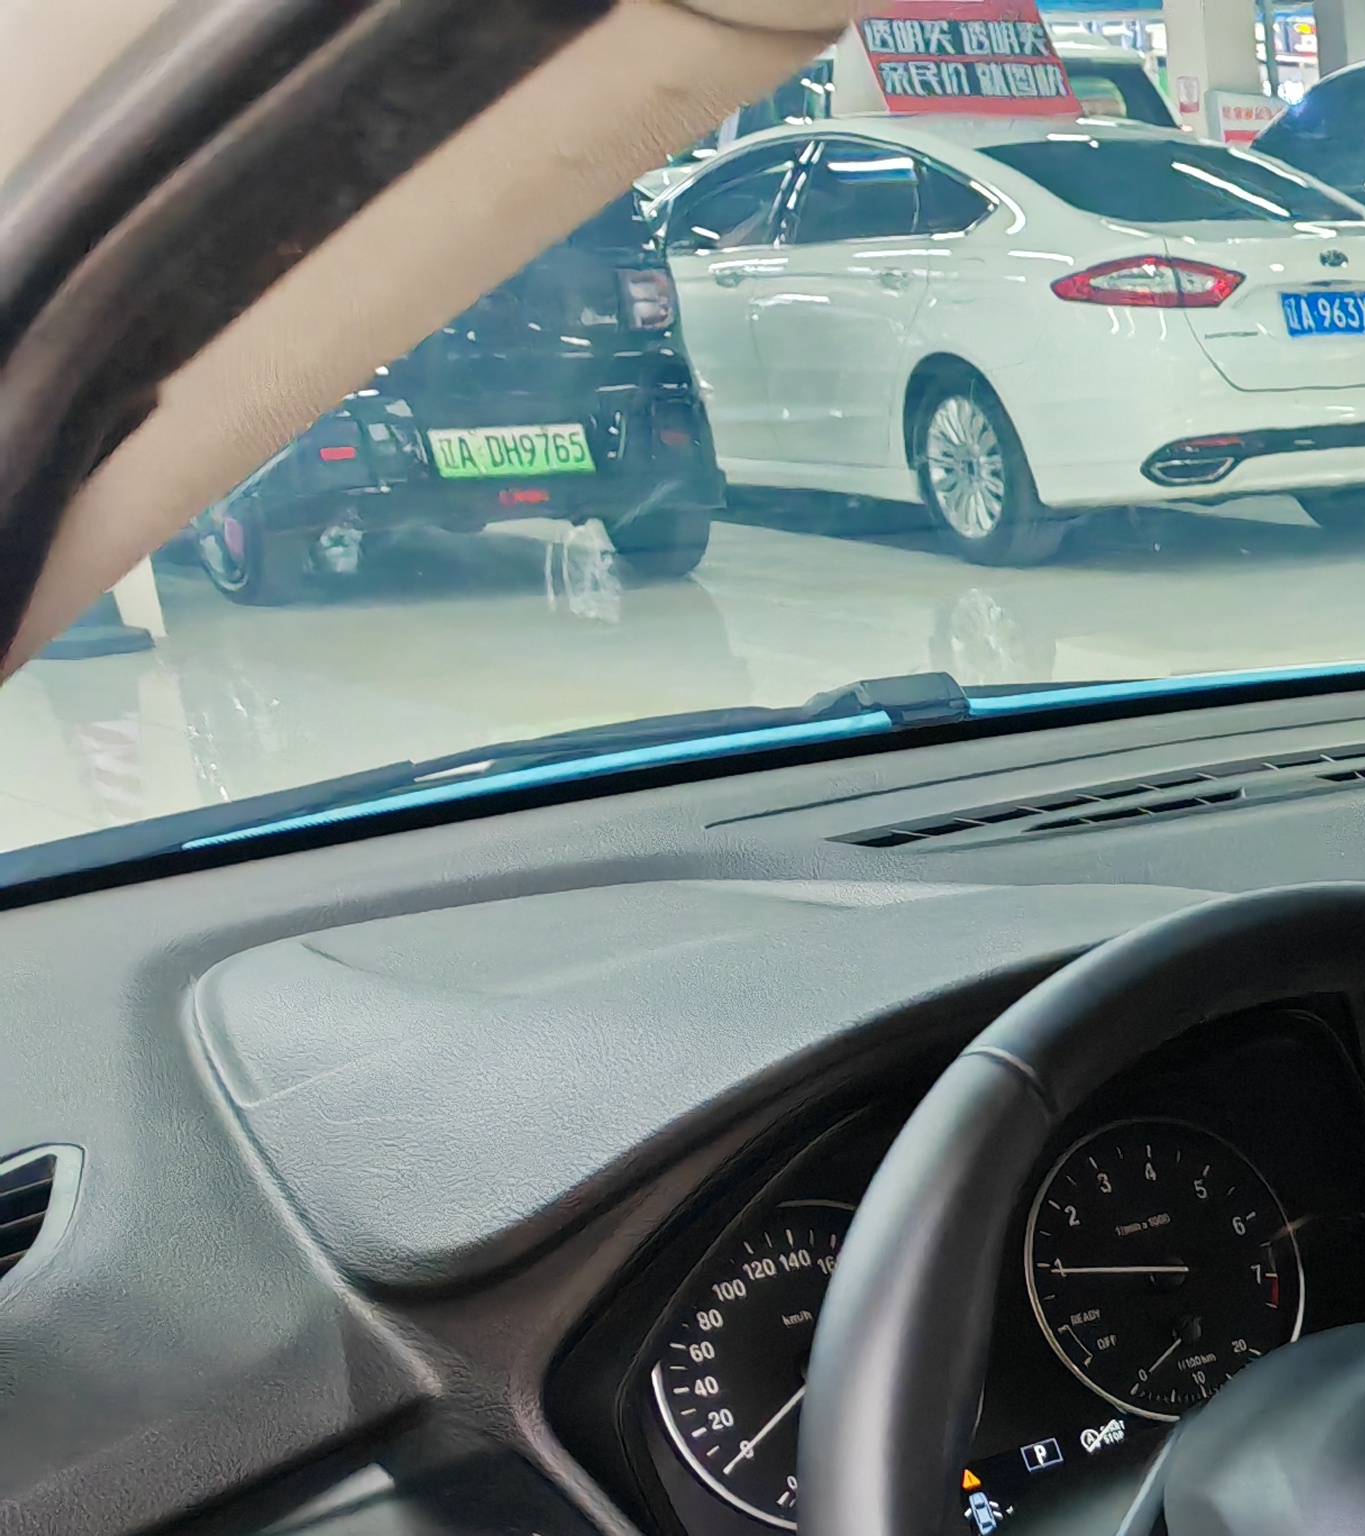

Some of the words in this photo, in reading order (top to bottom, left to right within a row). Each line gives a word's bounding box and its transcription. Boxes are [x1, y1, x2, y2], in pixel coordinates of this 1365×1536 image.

[1145, 1163, 1157, 1181] 4
[1097, 1173, 1112, 1193] 3
[1194, 1179, 1208, 1199] 5
[1064, 1206, 1080, 1226] 2
[1233, 1216, 1246, 1235] 6
[743, 1258, 777, 1280] 120
[779, 1249, 811, 1272] 140
[817, 1256, 839, 1275] 16
[712, 1279, 747, 1301] 100
[696, 1308, 724, 1330] 80
[689, 1341, 715, 1362] 60
[1231, 1339, 1247, 1353] 20
[694, 1376, 719, 1397] 40
[1191, 1371, 1207, 1385] 10
[708, 1408, 734, 1430] 20
[1033, 1444, 1047, 1466] P
